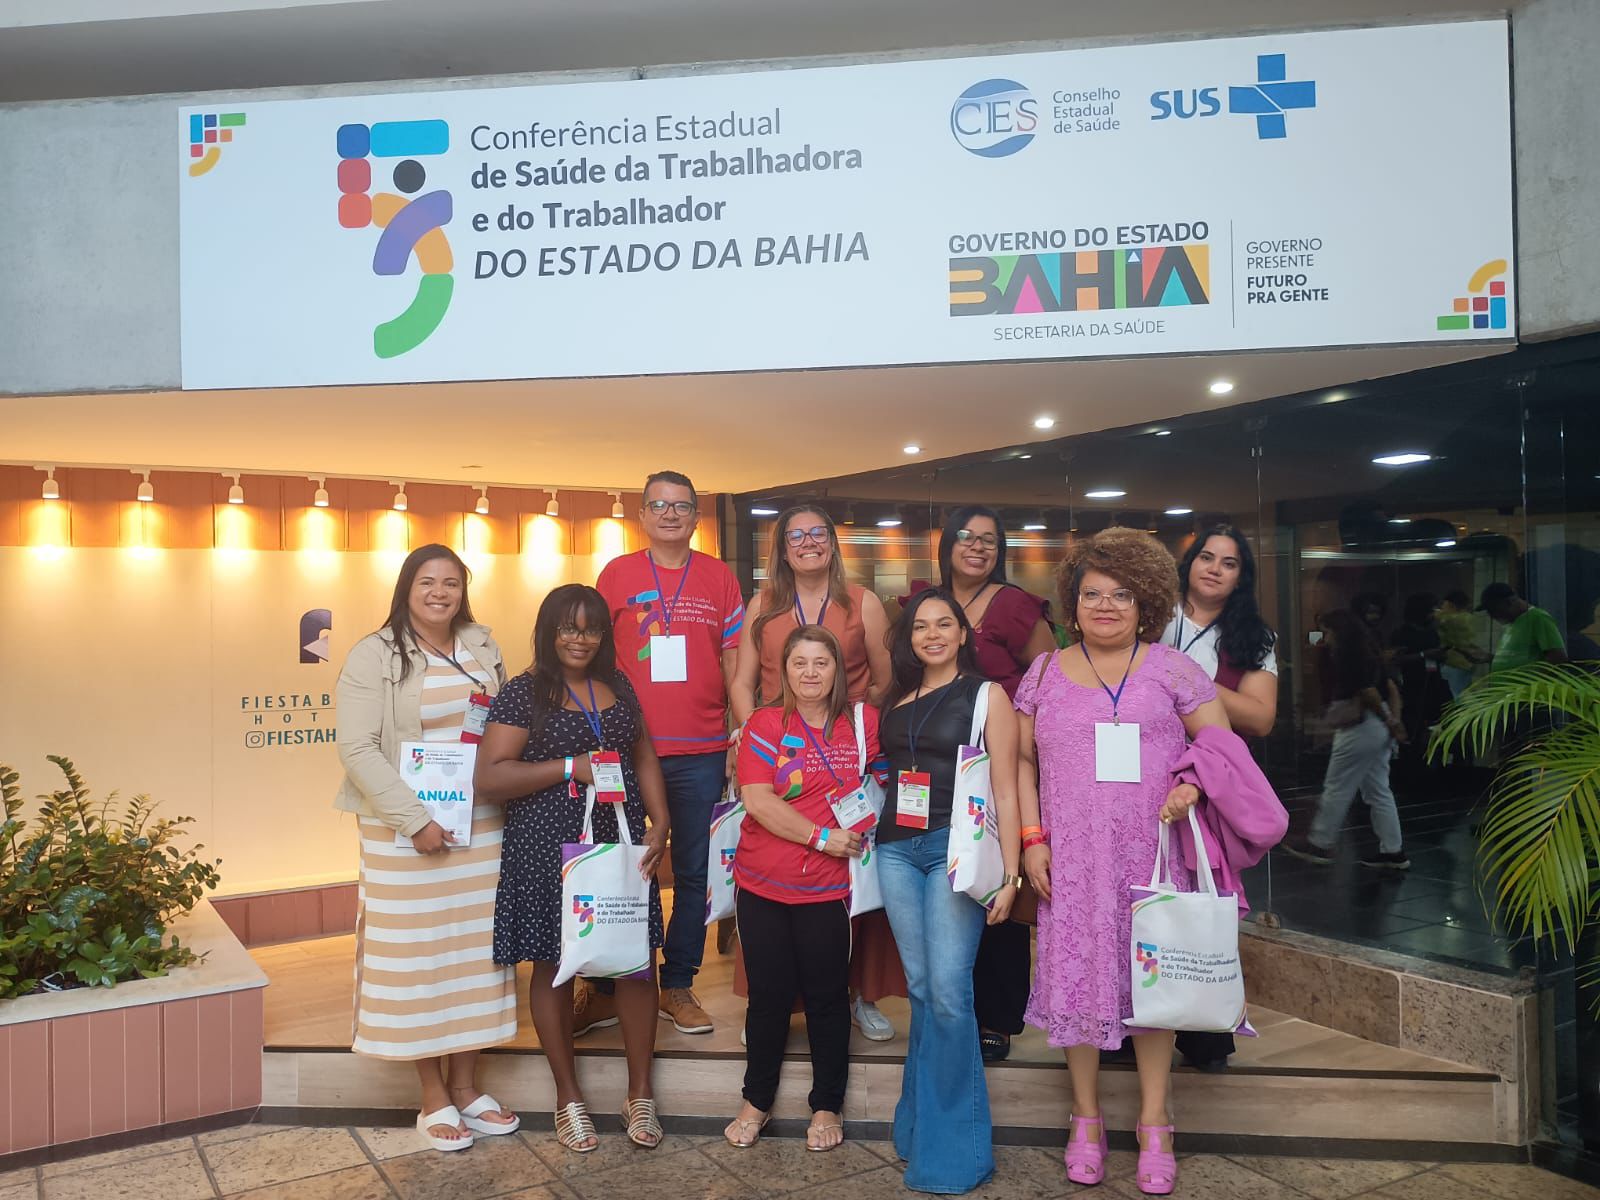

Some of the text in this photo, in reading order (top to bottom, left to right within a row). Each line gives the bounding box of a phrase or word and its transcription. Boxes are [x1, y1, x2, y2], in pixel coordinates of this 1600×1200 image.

[1052, 88, 1121, 104] Conselho
[1149, 87, 1221, 121] SUS
[1053, 102, 1114, 120] Estadual
[470, 107, 781, 151] Conferência Estadual
[1053, 117, 1121, 134] de Saúde
[471, 143, 863, 189] de Saúde da Trabalhadora
[471, 195, 727, 233] e do Trabalhador
[948, 220, 1209, 255] GOVERNO DO ESTADO
[1246, 238, 1323, 254] GOVERNO
[473, 231, 870, 280] DO ESTADO DA BAHIA
[1247, 254, 1315, 270] PRESENTE
[1247, 273, 1308, 289] FUTURO
[1247, 288, 1329, 305] PRA GENTE
[993, 318, 1166, 341] SECRETARIA DA SAÚDE
[241, 694, 312, 709] FIESTA
[416, 790, 467, 802] ANUAL
